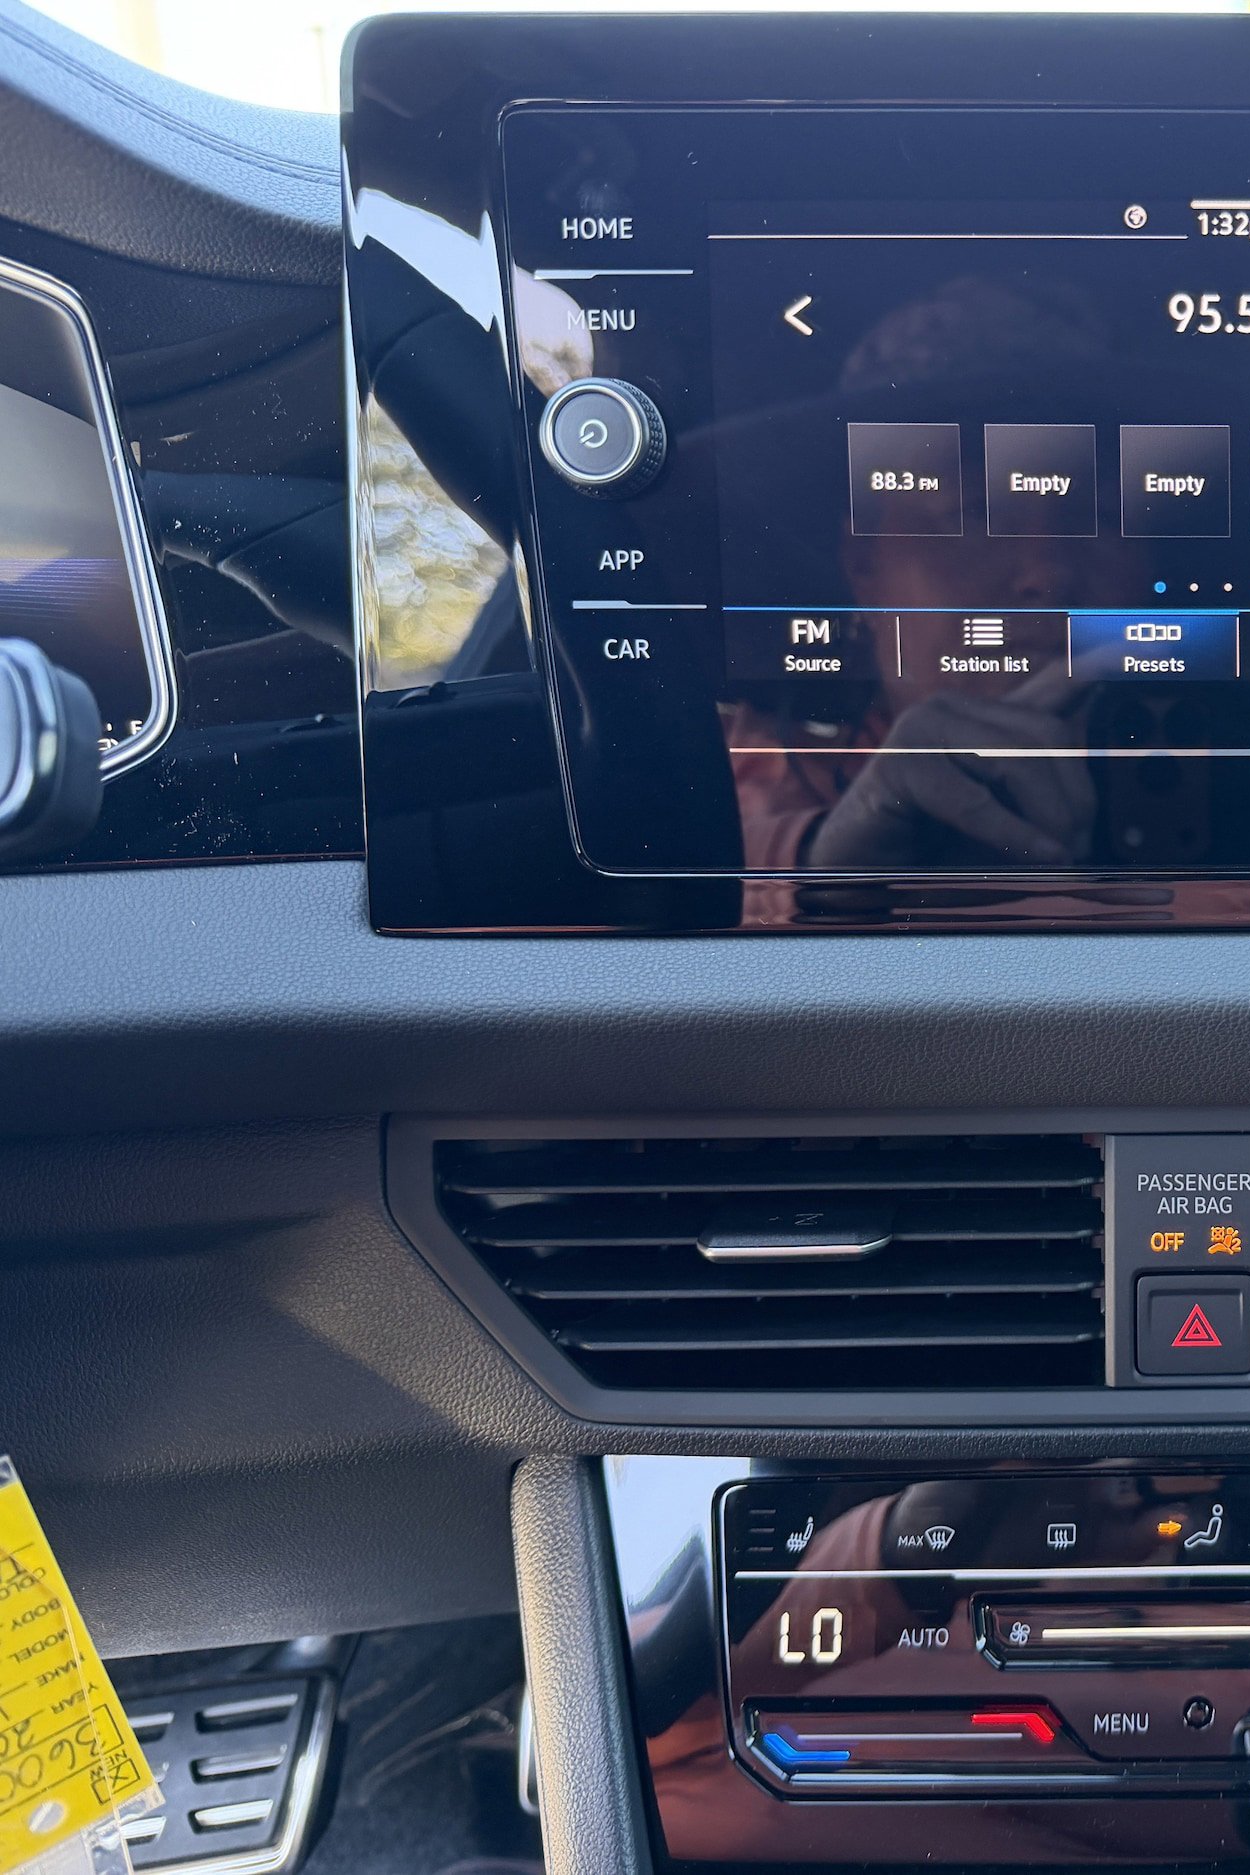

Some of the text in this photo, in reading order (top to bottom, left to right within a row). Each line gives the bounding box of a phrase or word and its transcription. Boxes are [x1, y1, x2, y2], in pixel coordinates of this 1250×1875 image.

[562, 217, 634, 240] HOME
[567, 309, 636, 331] MENU
[871, 471, 939, 491] 88.3 FM
[1010, 472, 1071, 496] Empty
[1145, 473, 1205, 496] Empty
[599, 549, 645, 571] APP
[791, 619, 830, 644] FM
[603, 638, 651, 660] CAR
[784, 654, 842, 672] Source
[940, 655, 1030, 673] Station list
[1124, 656, 1186, 672] Presets
[1157, 1196, 1233, 1214] AIR BAG
[1150, 1232, 1185, 1252] OFF
[897, 1535, 924, 1547] MAX
[11, 1598, 60, 1631] BODY
[779, 1607, 843, 1663] LO
[897, 1627, 949, 1648] AUTO
[50, 1682, 98, 1714] YEAR
[1093, 1712, 1149, 1733] MENU
[90, 1749, 127, 1781] NEW
